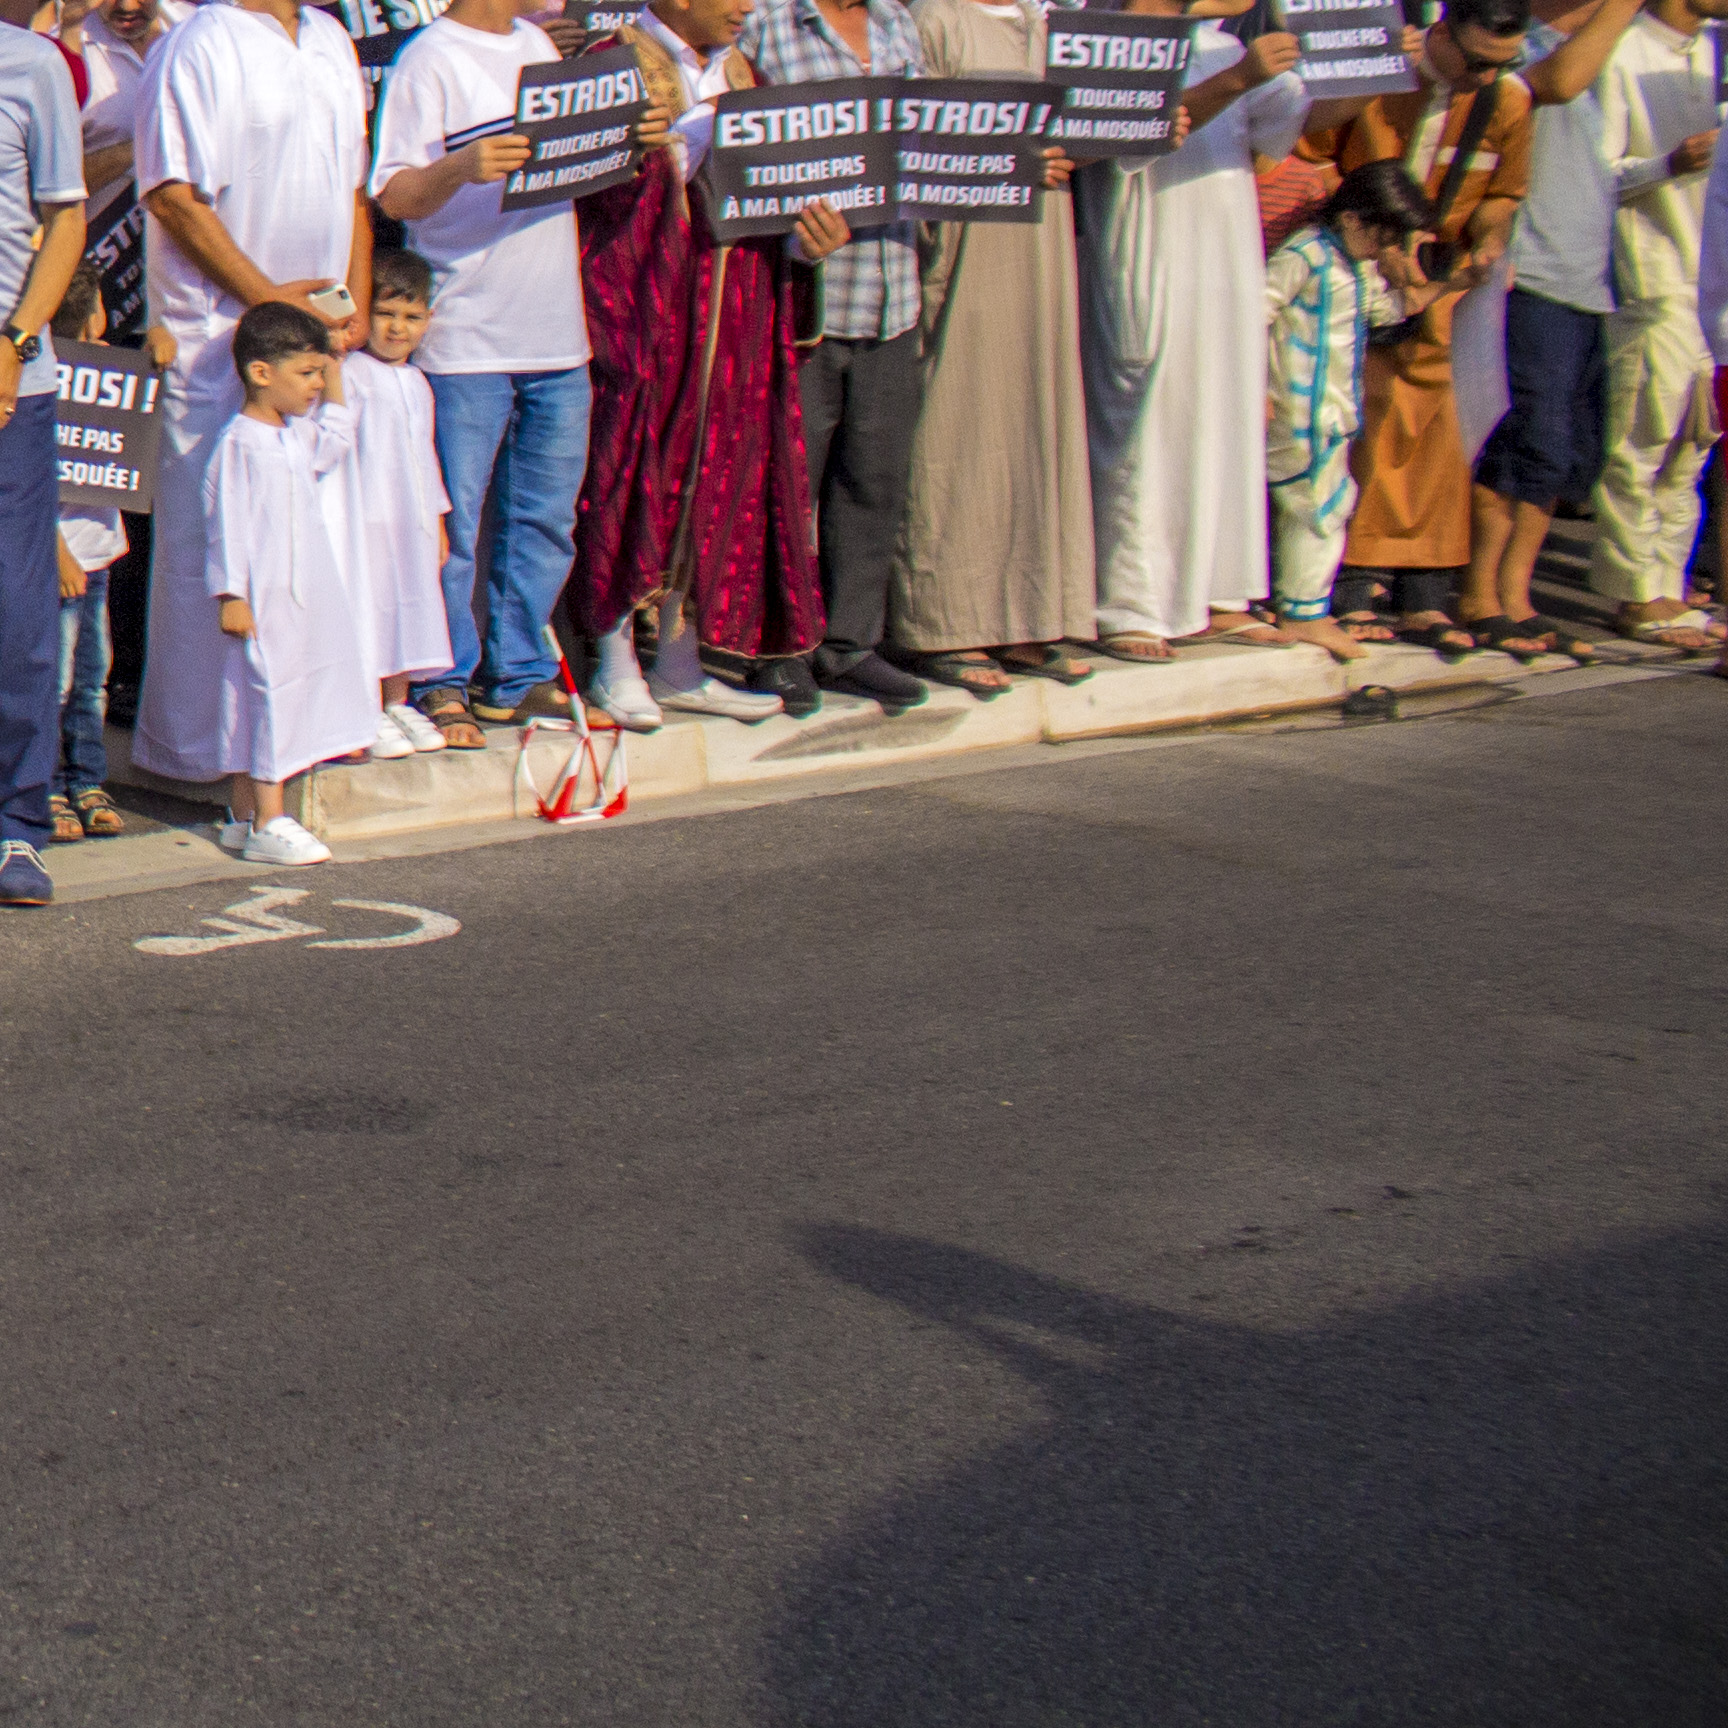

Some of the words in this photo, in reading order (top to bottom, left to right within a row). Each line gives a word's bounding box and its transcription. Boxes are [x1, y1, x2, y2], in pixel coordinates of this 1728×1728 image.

[1048, 33, 1179, 71] ESTROSI
[518, 69, 640, 123] ESTROSI
[1067, 87, 1138, 109] TOUCHE
[716, 98, 869, 149] ESTROSI
[1046, 116, 1064, 137] À
[1064, 119, 1094, 139] MA
[1094, 118, 1166, 141] MOSQUÉE
[536, 131, 601, 161] TOUCHE
[745, 160, 830, 187] TOUCHE
[831, 155, 865, 178] PAS
[979, 154, 1016, 175] PAS
[507, 170, 526, 194] À
[526, 170, 554, 192] MA
[920, 182, 1021, 207] MOSQUÉE
[720, 194, 741, 220] À
[742, 197, 781, 218] MA
[81, 430, 125, 455] PAS
